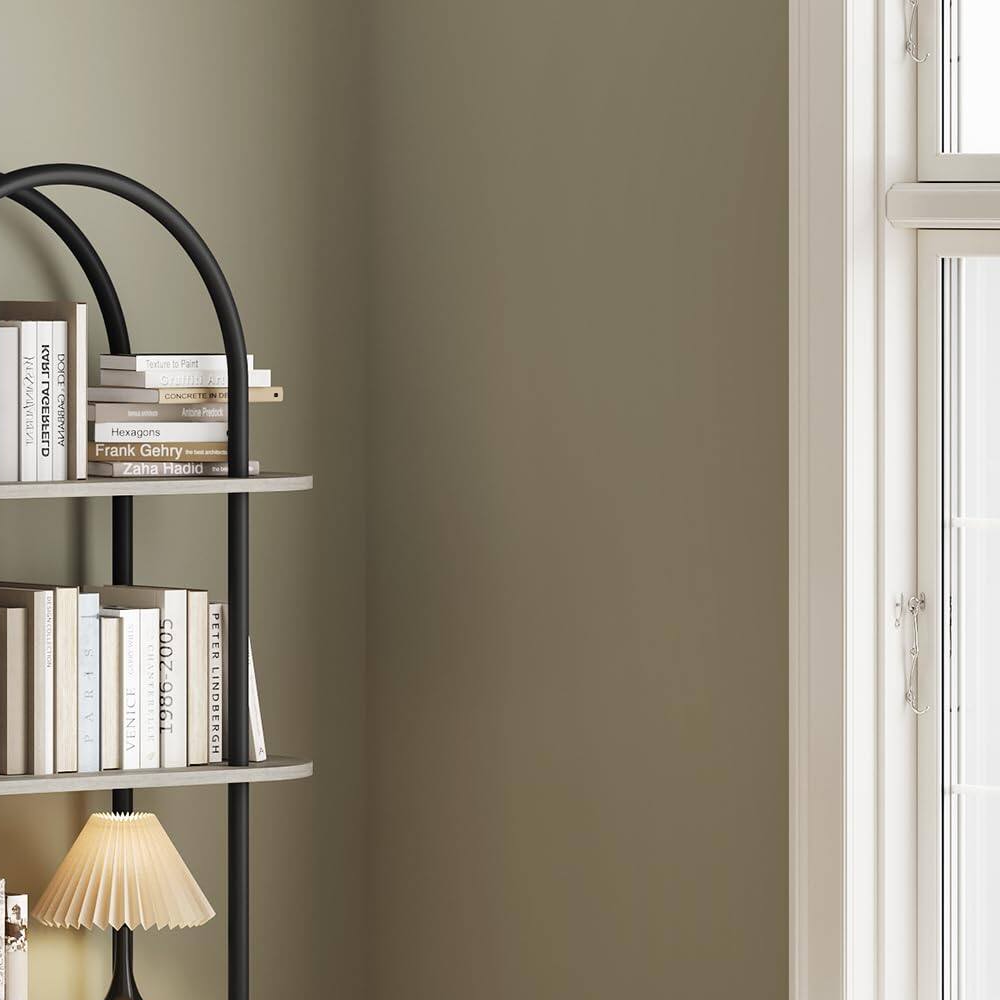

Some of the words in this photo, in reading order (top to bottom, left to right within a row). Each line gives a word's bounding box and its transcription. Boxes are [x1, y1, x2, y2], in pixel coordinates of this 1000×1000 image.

[145, 360, 170, 369] Texture
[172, 360, 179, 369] to
[181, 359, 199, 369] Paint
[95, 444, 136, 457] Frank
[140, 444, 183, 460] Gehry
[112, 428, 161, 438] Hexagons
[123, 463, 158, 475] Zaha
[163, 463, 203, 475] Hadid
[212, 614, 220, 658] PETER
[83, 648, 95, 743] PARIS
[159, 618, 173, 734] 1986-2005
[126, 688, 136, 751] VENICE
[212, 667, 220, 753] LINDBERGH
